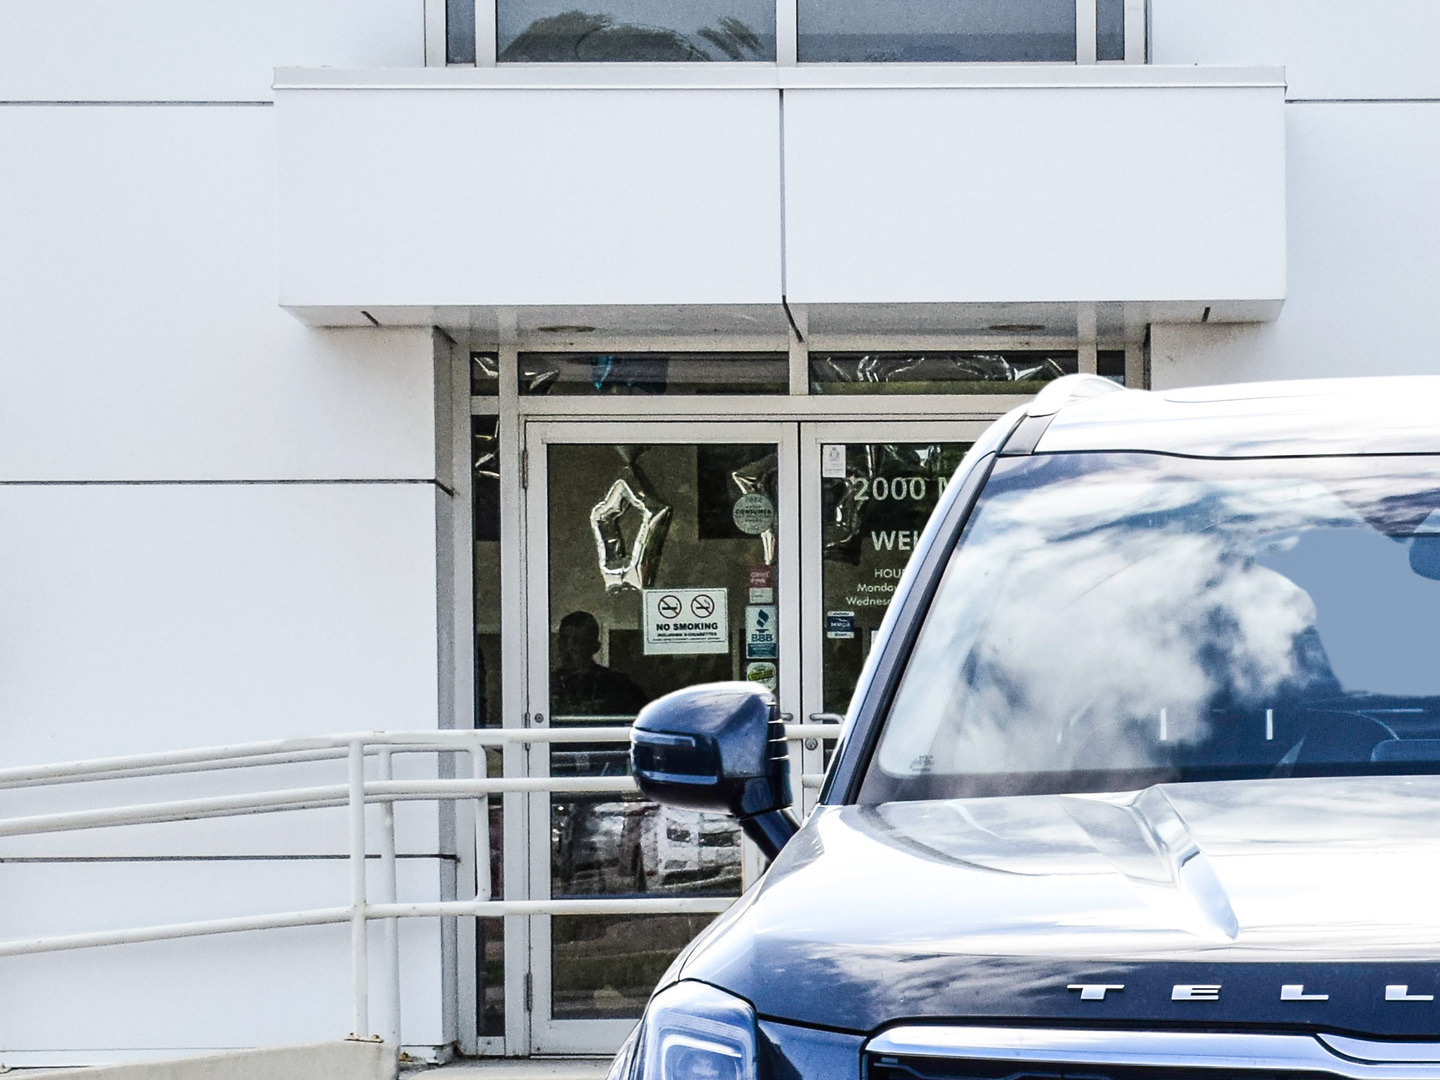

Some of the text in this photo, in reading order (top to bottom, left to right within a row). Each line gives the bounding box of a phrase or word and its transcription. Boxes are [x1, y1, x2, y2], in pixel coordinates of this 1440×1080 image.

[853, 476, 927, 501] 2000
[874, 568, 905, 579] HOU
[656, 622, 718, 631] NO SMOKING
[751, 633, 773, 642] BBB
